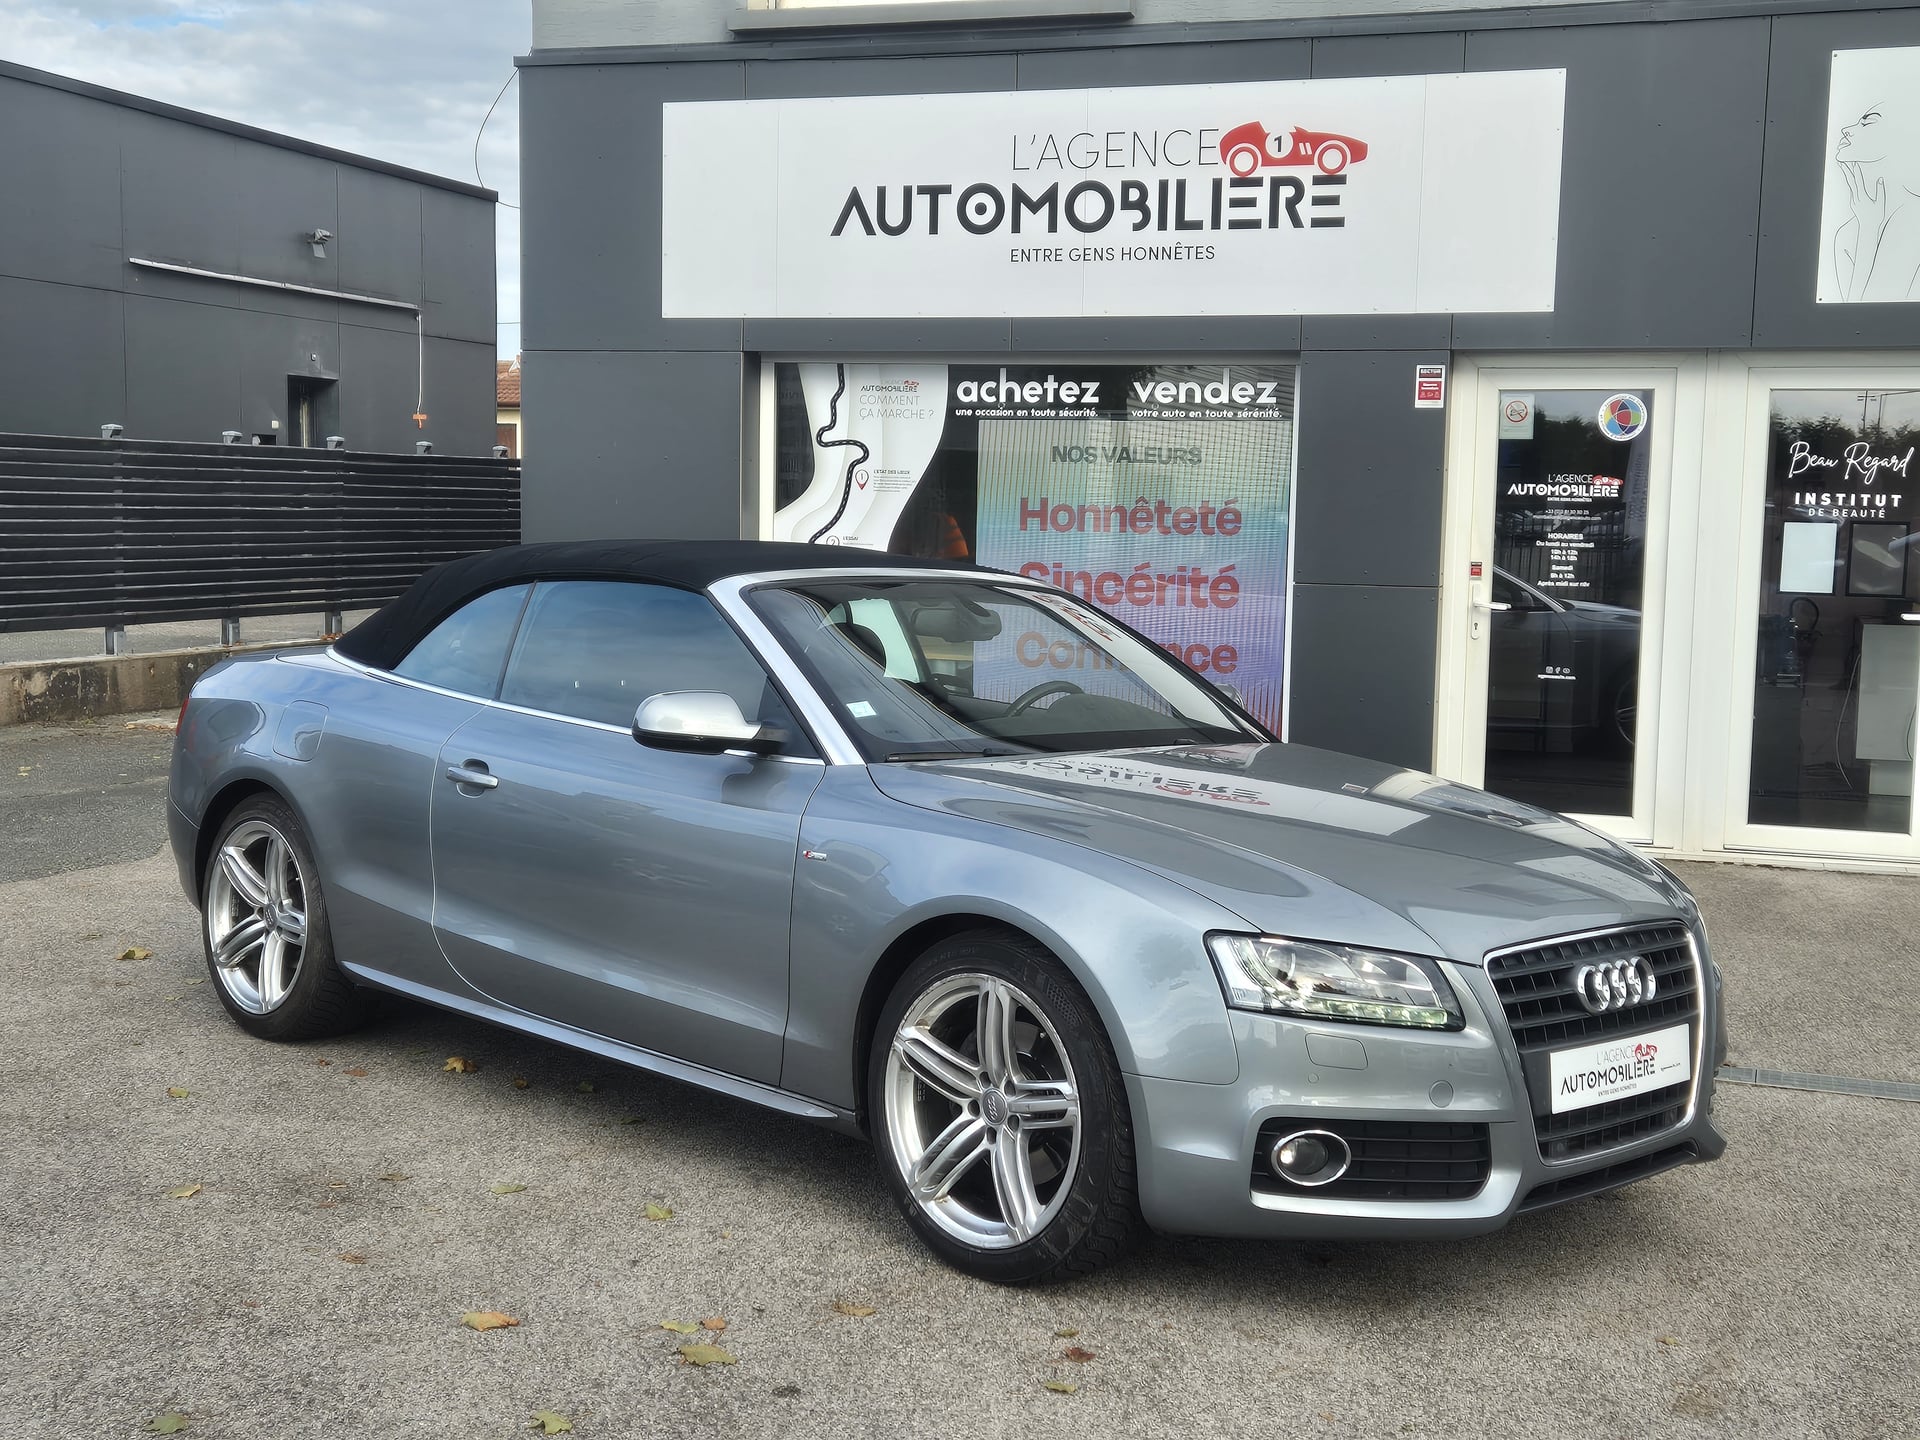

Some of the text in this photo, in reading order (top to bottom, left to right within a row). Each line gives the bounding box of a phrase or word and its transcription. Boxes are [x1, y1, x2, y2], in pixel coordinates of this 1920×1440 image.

[1012, 128, 1219, 171] L'AGENCE
[1010, 241, 1215, 263] ENTRE GENS HONNÊTES
[956, 367, 1100, 404] achetez
[1132, 367, 1278, 405] vendez
[859, 394, 920, 406] COMMENT
[859, 407, 874, 420] ÇA
[876, 408, 925, 419] MARCHE
[955, 406, 1099, 417] une occasion en toute sécurité.
[1131, 407, 1283, 418] votre auto en toute sérénité.
[1051, 445, 1203, 466] NOS VALEURS
[1788, 441, 1915, 485] Beau Regard
[1548, 474, 1594, 484] L'AGENCE
[1794, 492, 1902, 508] INSTITUT
[1019, 495, 1243, 537] Honnêteté
[1808, 507, 1886, 518] DE BEAUTÉ
[1547, 532, 1584, 540] HORAIRES
